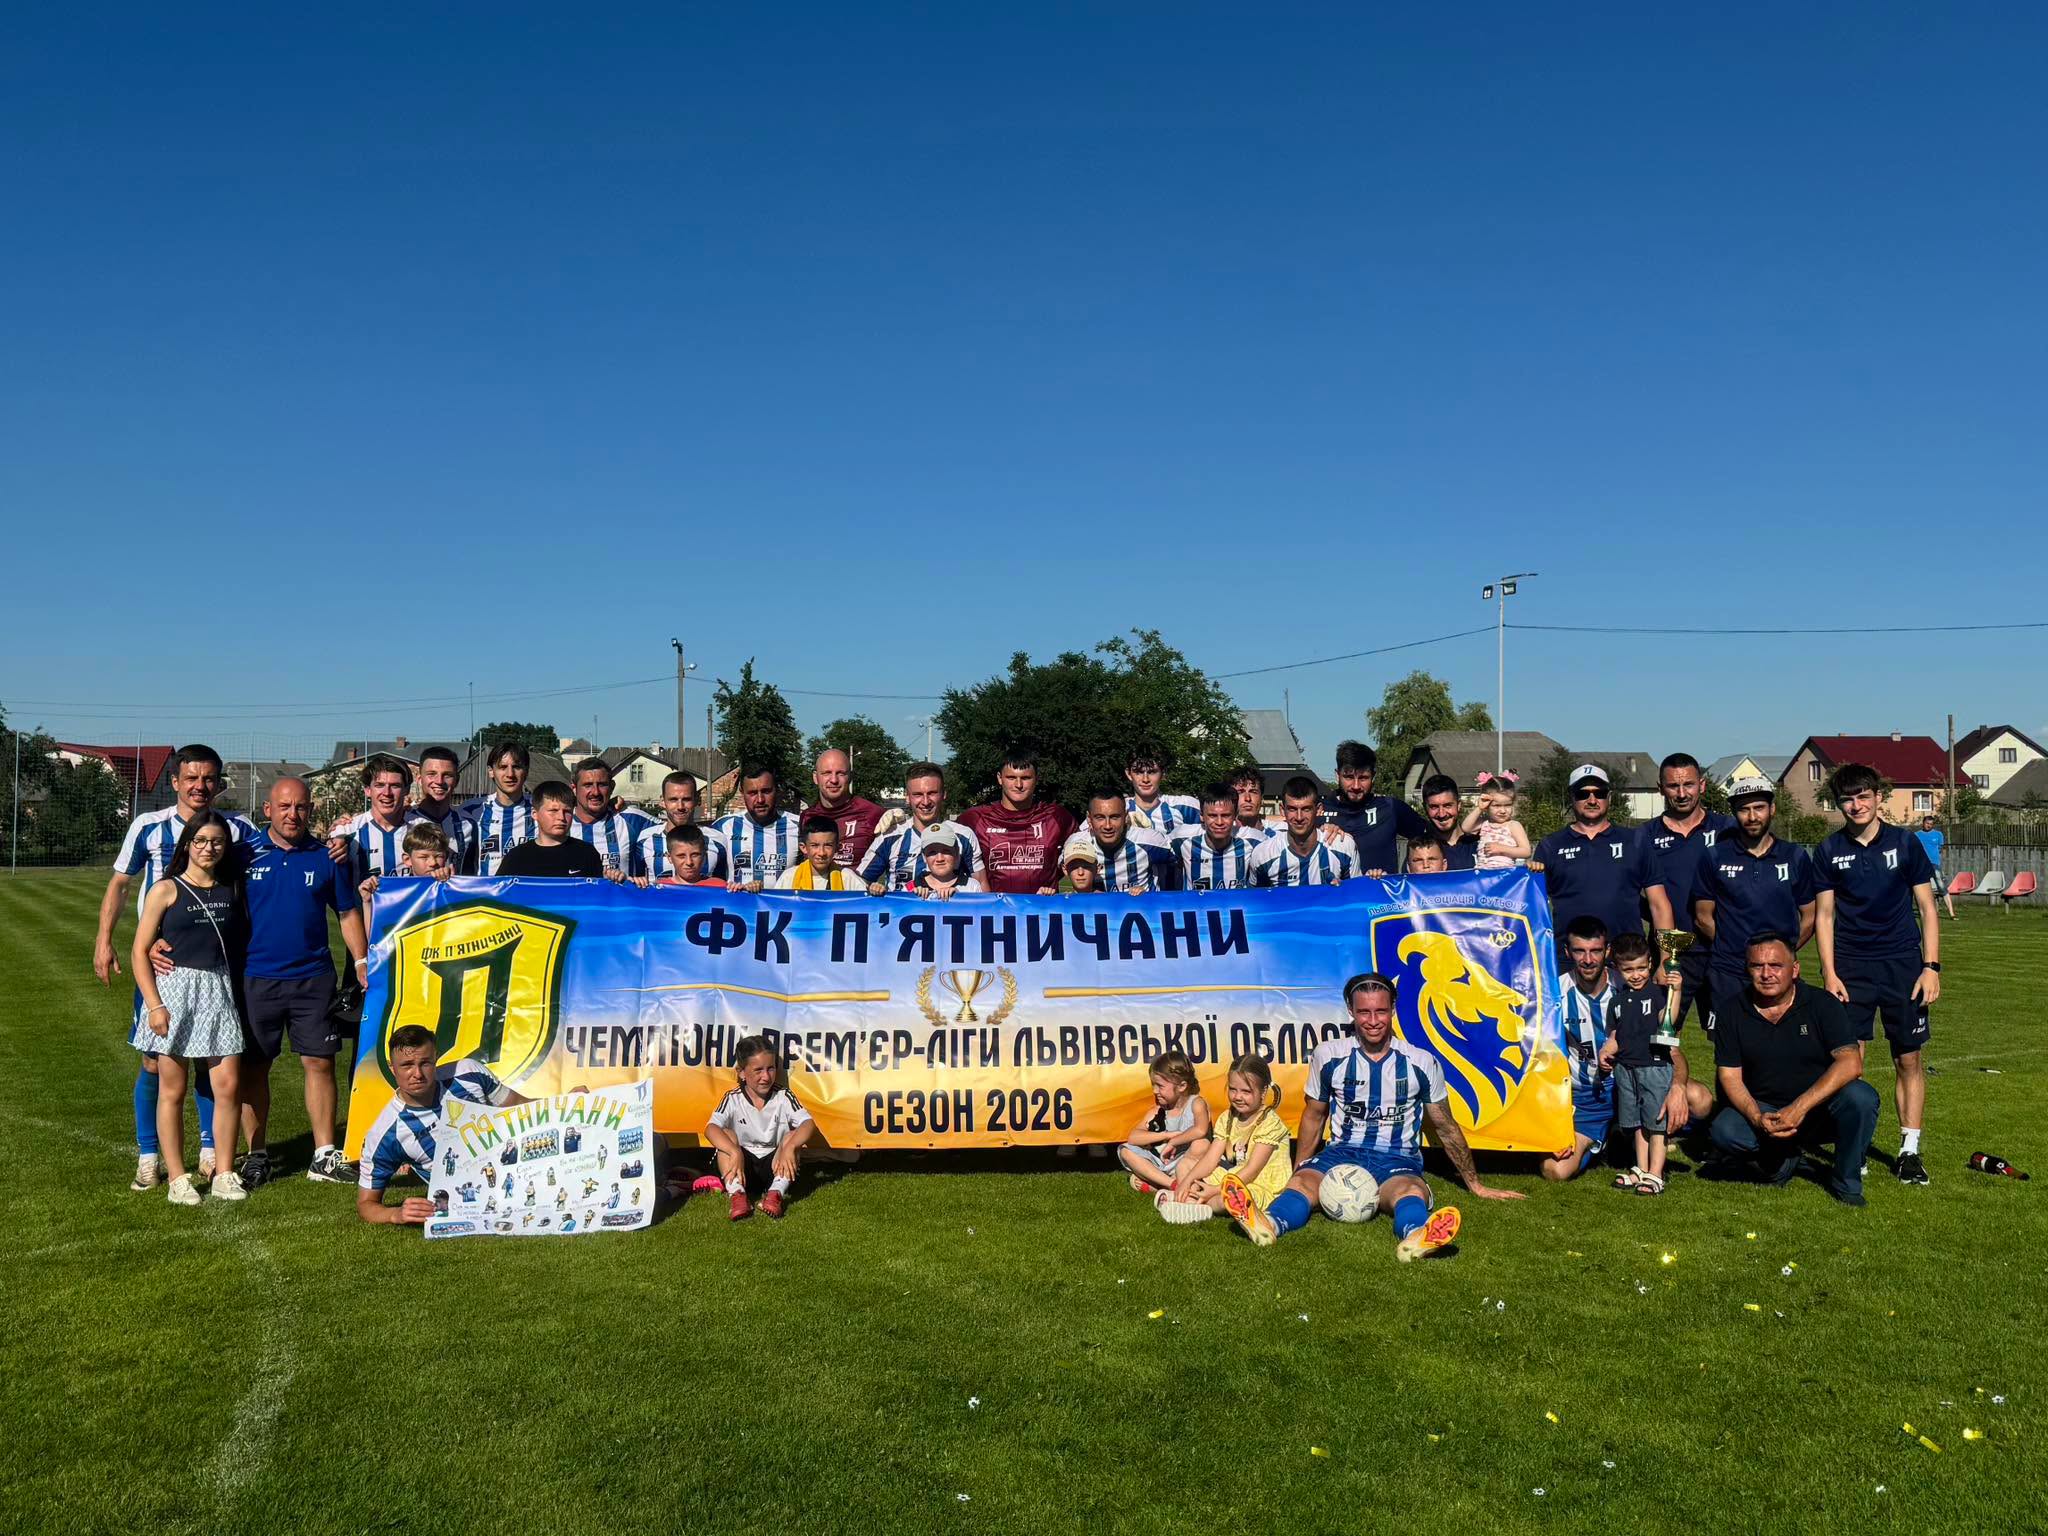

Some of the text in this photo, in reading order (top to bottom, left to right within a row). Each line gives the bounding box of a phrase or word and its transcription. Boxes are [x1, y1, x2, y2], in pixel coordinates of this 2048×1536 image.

[1012, 844, 1045, 859] APS
[1832, 854, 1856, 864] Zeus
[685, 907, 1250, 964] ФК П'ЯТНИЧАНИ
[421, 946, 440, 961] ФК
[1013, 1014, 1219, 1068] ЛЬВІВСЬКОЇ
[864, 1087, 1073, 1134] СЕЗОН 2026
